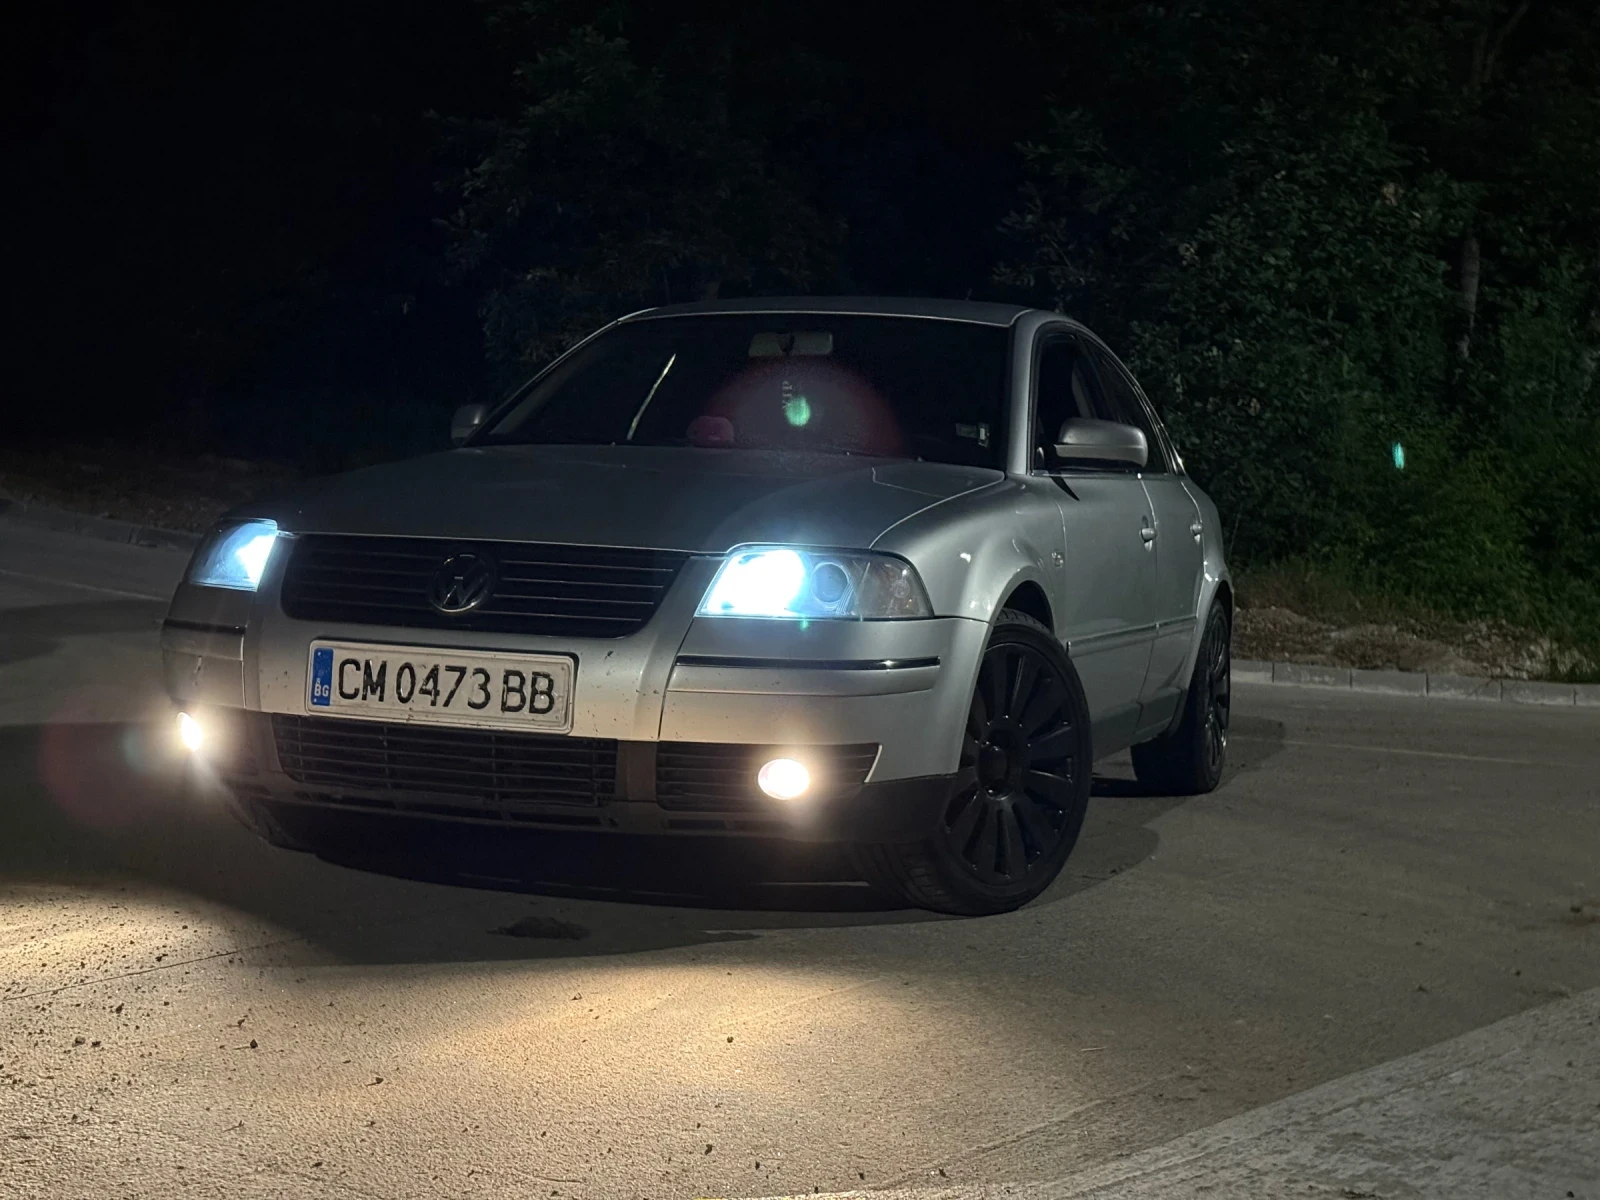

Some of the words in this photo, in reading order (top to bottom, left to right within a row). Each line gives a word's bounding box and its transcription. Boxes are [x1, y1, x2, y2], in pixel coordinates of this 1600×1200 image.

[314, 682, 330, 698] BG
[338, 658, 387, 702] CM
[395, 662, 491, 710] 0473
[500, 669, 555, 715] BB
